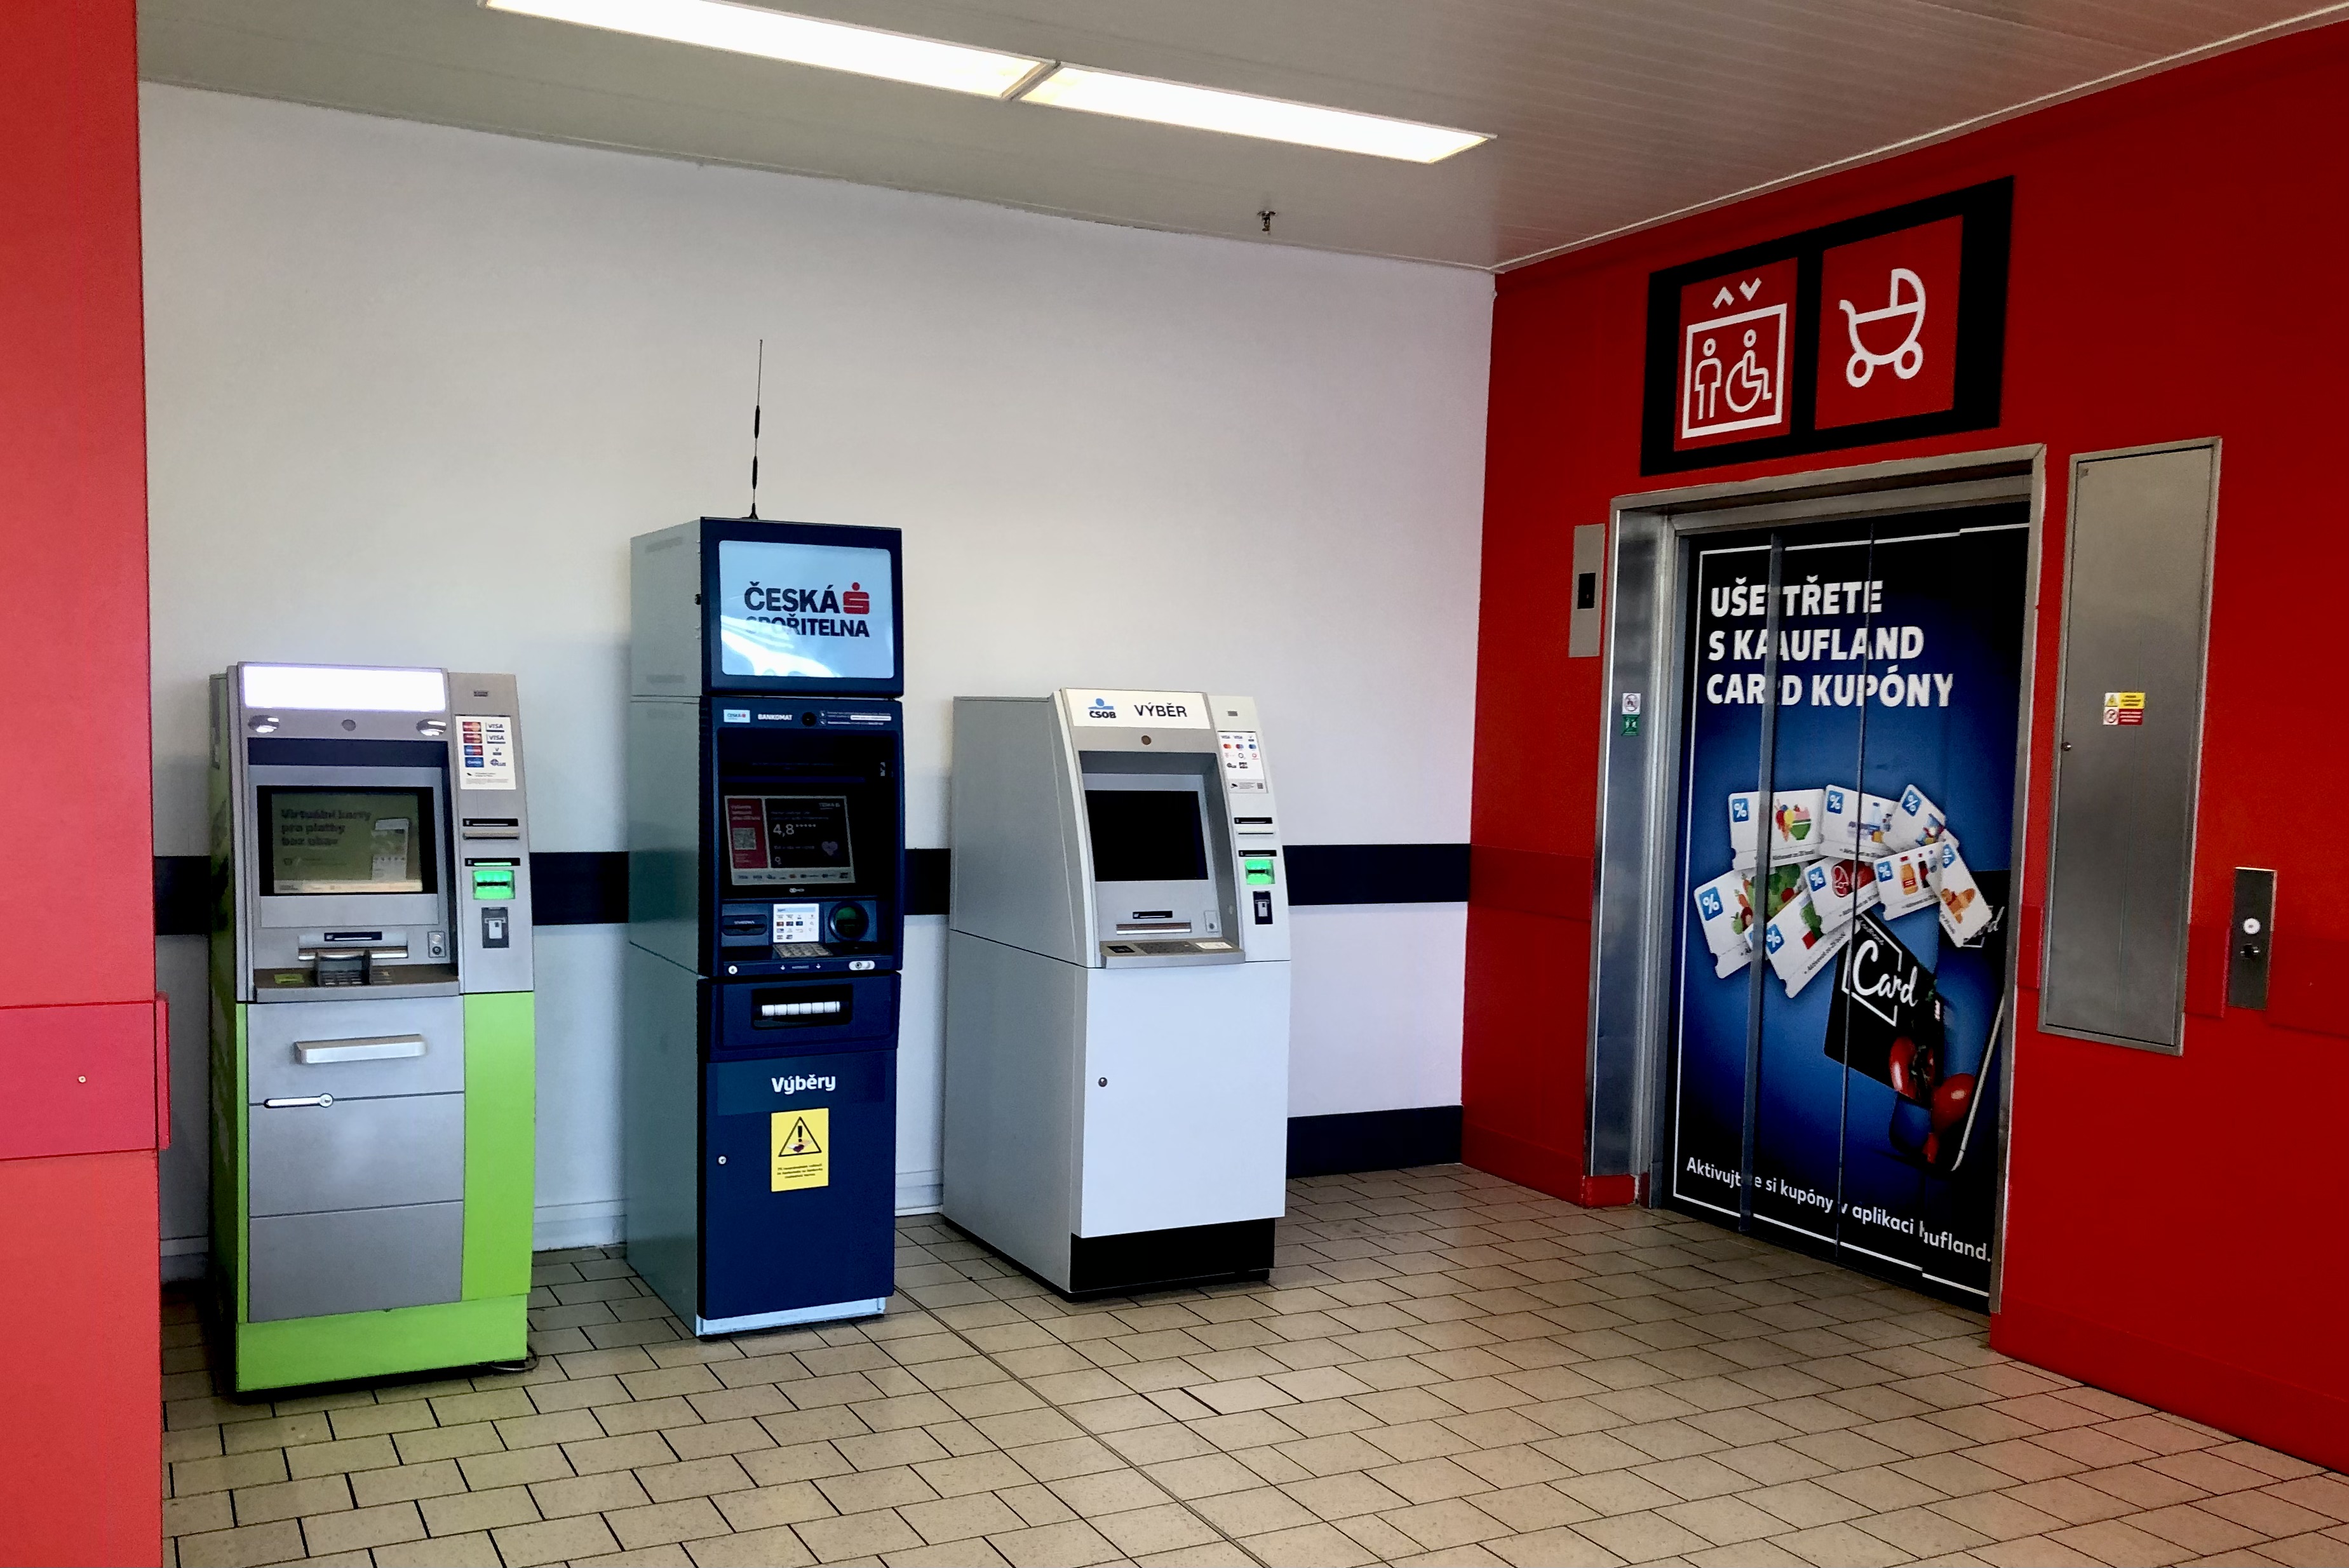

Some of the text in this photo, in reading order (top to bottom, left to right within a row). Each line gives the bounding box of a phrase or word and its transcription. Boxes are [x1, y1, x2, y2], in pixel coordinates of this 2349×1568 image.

[744, 581, 840, 614] ČESKÁ
[1711, 575, 1883, 617] UŠETŘETE
[1707, 626, 1925, 661] S KAUFLAND
[1706, 665, 1954, 707] CARD KUPÓNY
[1089, 710, 1117, 719] ČSOB
[1134, 702, 1188, 718] VÝBĚR
[772, 823, 795, 838] 4,8
[1852, 940, 1918, 1007] Card
[771, 1074, 836, 1095] Výběry
[1686, 1156, 1762, 1189] Aktivujte
[1765, 1177, 1777, 1193] si
[1780, 1179, 1834, 1214] kupóny
[1852, 1206, 1915, 1235] aplikaci
